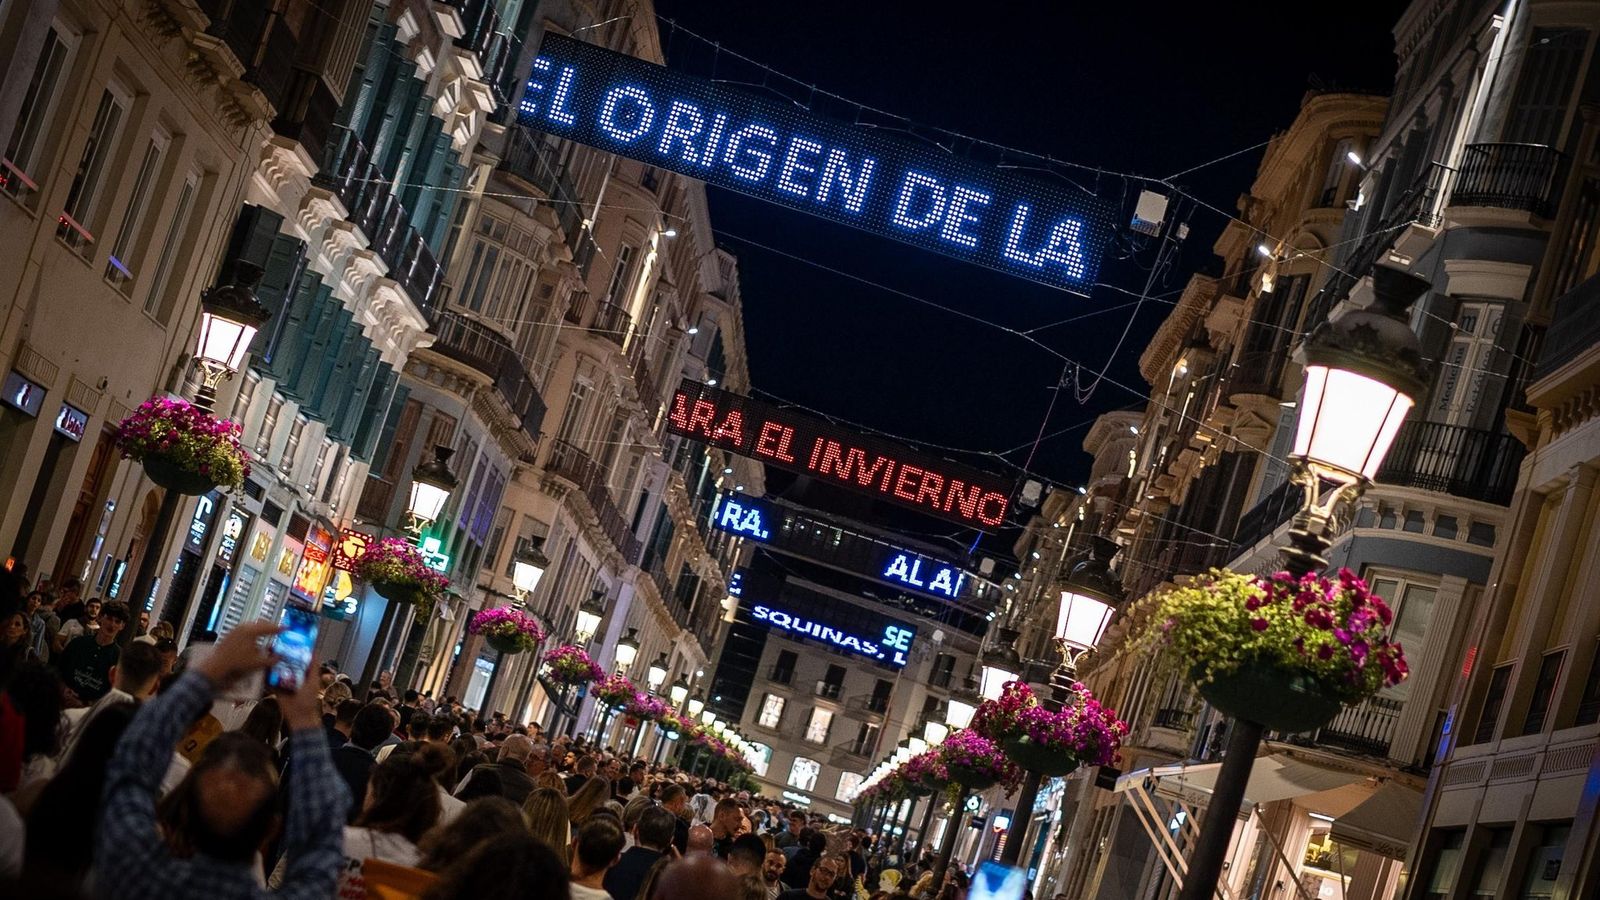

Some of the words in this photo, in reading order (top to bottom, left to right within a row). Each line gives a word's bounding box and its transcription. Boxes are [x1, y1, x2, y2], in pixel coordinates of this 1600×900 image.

[599, 86, 875, 212] ORIGEN
[893, 170, 990, 248] DE
[1003, 203, 1085, 279] LA
[756, 421, 795, 463] EL
[807, 437, 1008, 526] INVIERNO
[714, 501, 769, 539] RA.
[884, 554, 923, 587] AL
[882, 625, 913, 651] SE
